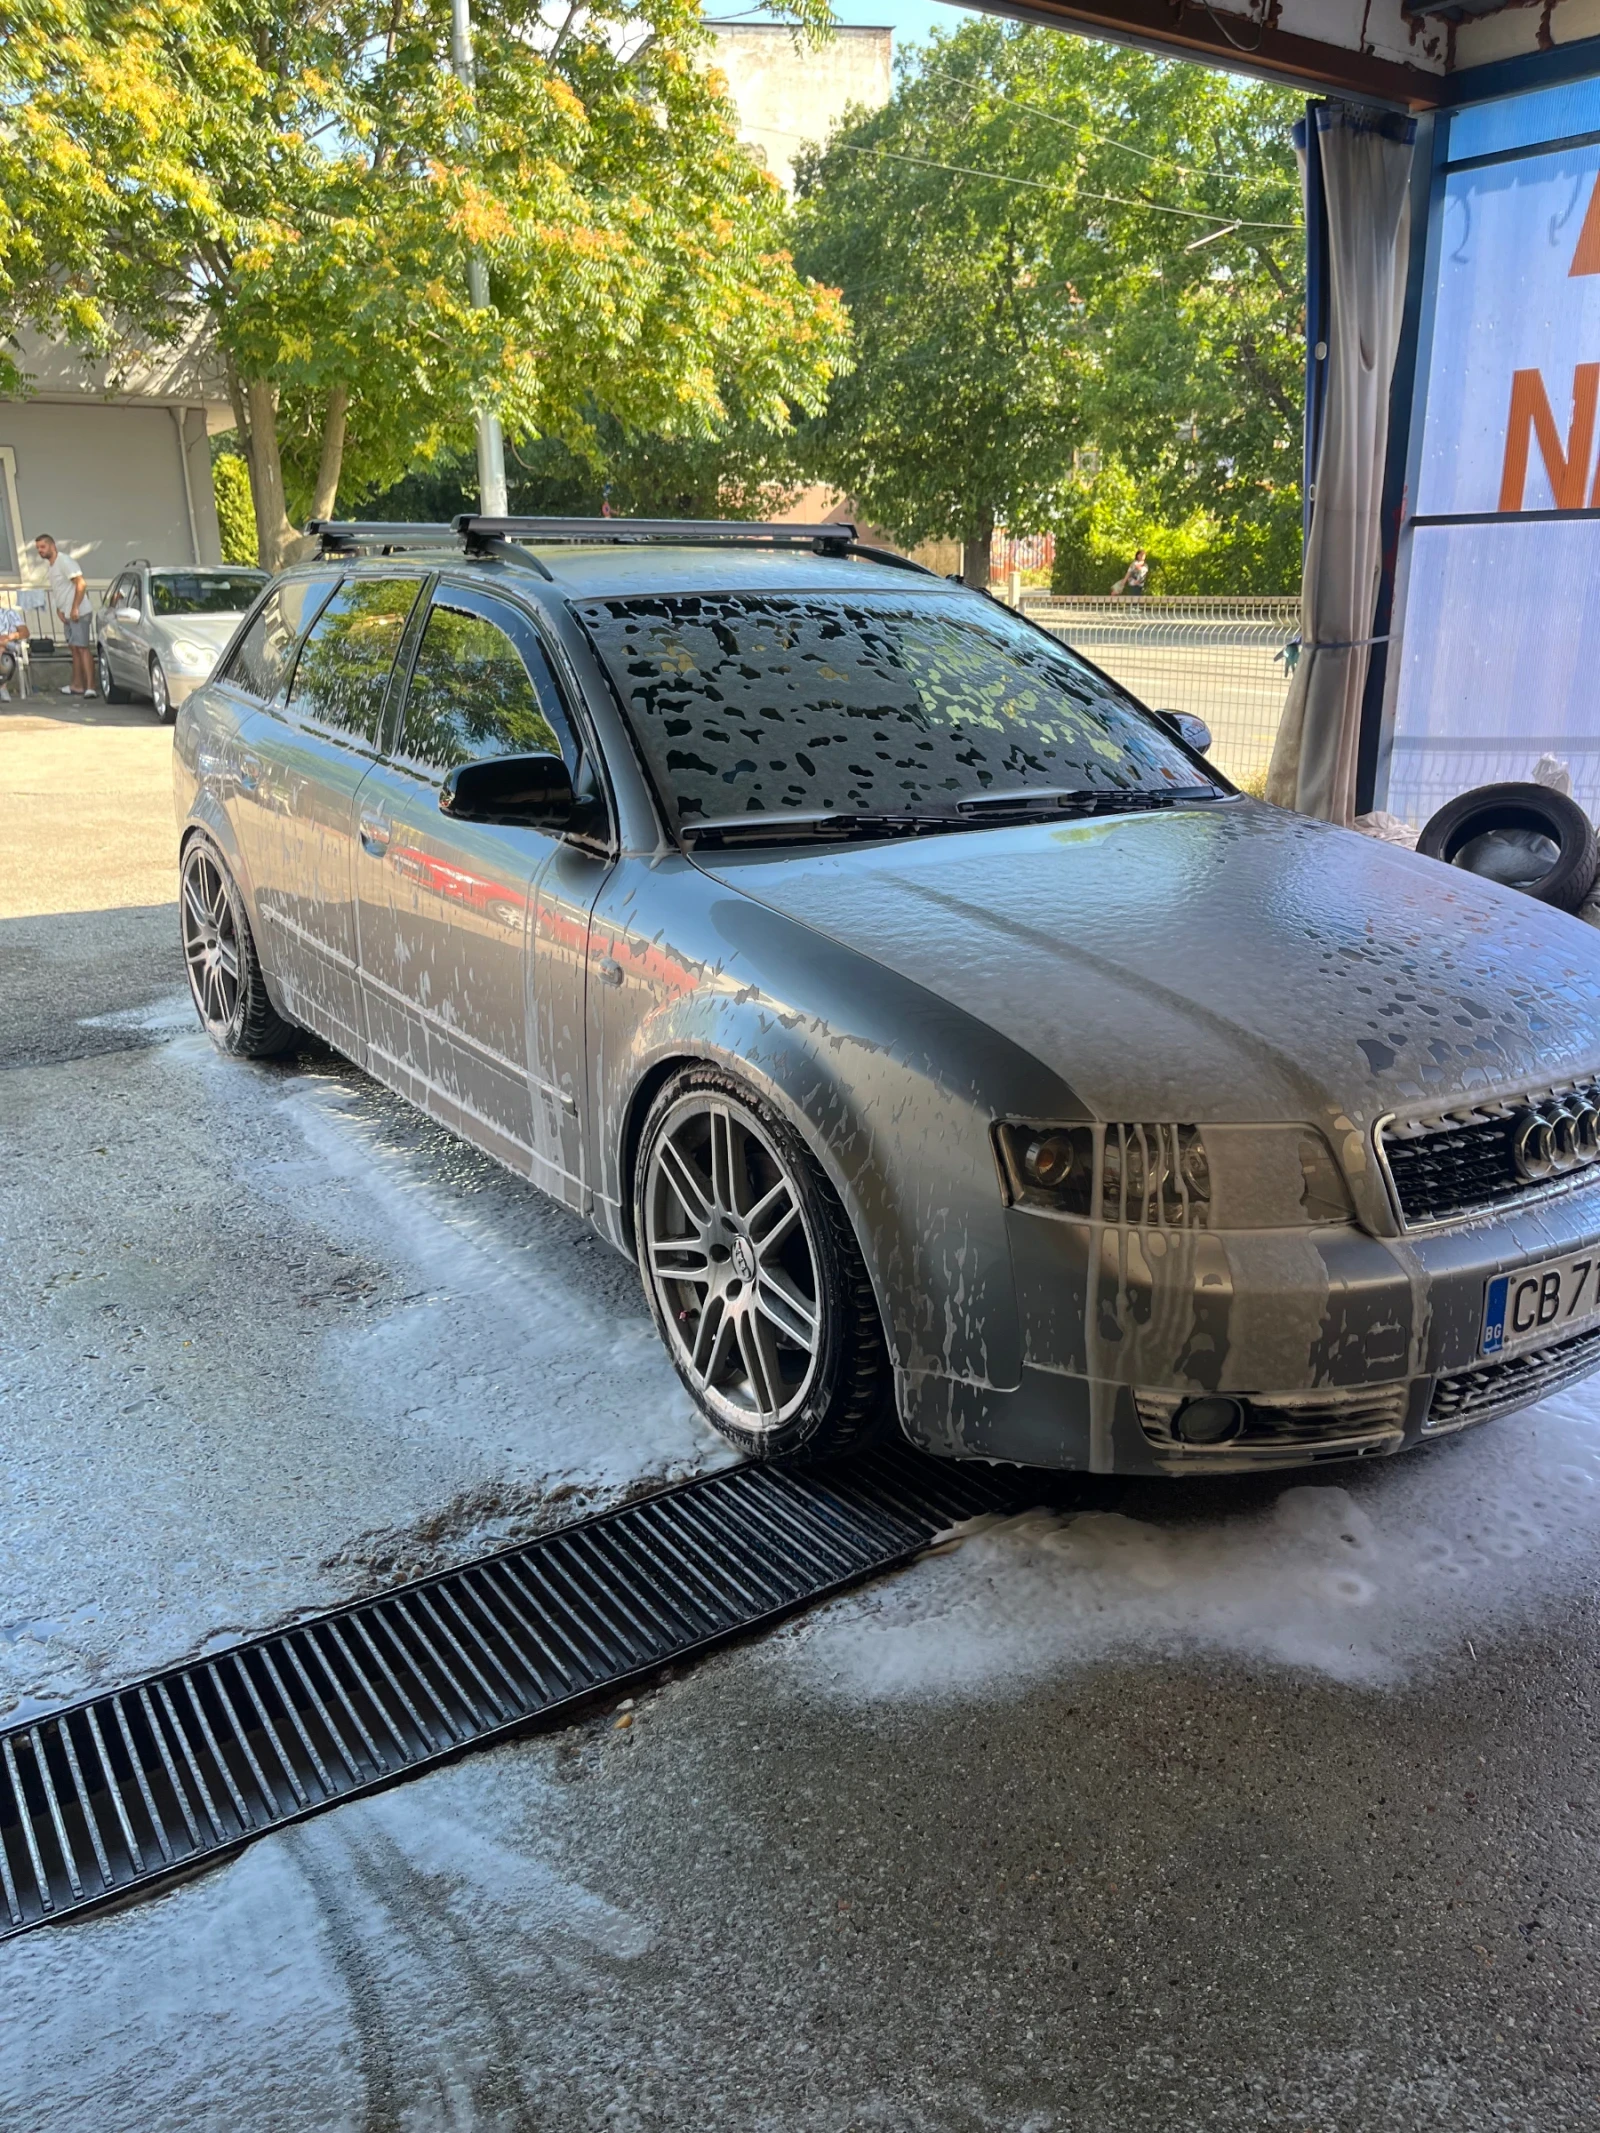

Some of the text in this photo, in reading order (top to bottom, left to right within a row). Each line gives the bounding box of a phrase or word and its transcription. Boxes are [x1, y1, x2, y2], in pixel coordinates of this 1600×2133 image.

[1497, 362, 1600, 512] N
[1485, 1323, 1502, 1343] BG
[1512, 1259, 1600, 1333] CB 7
